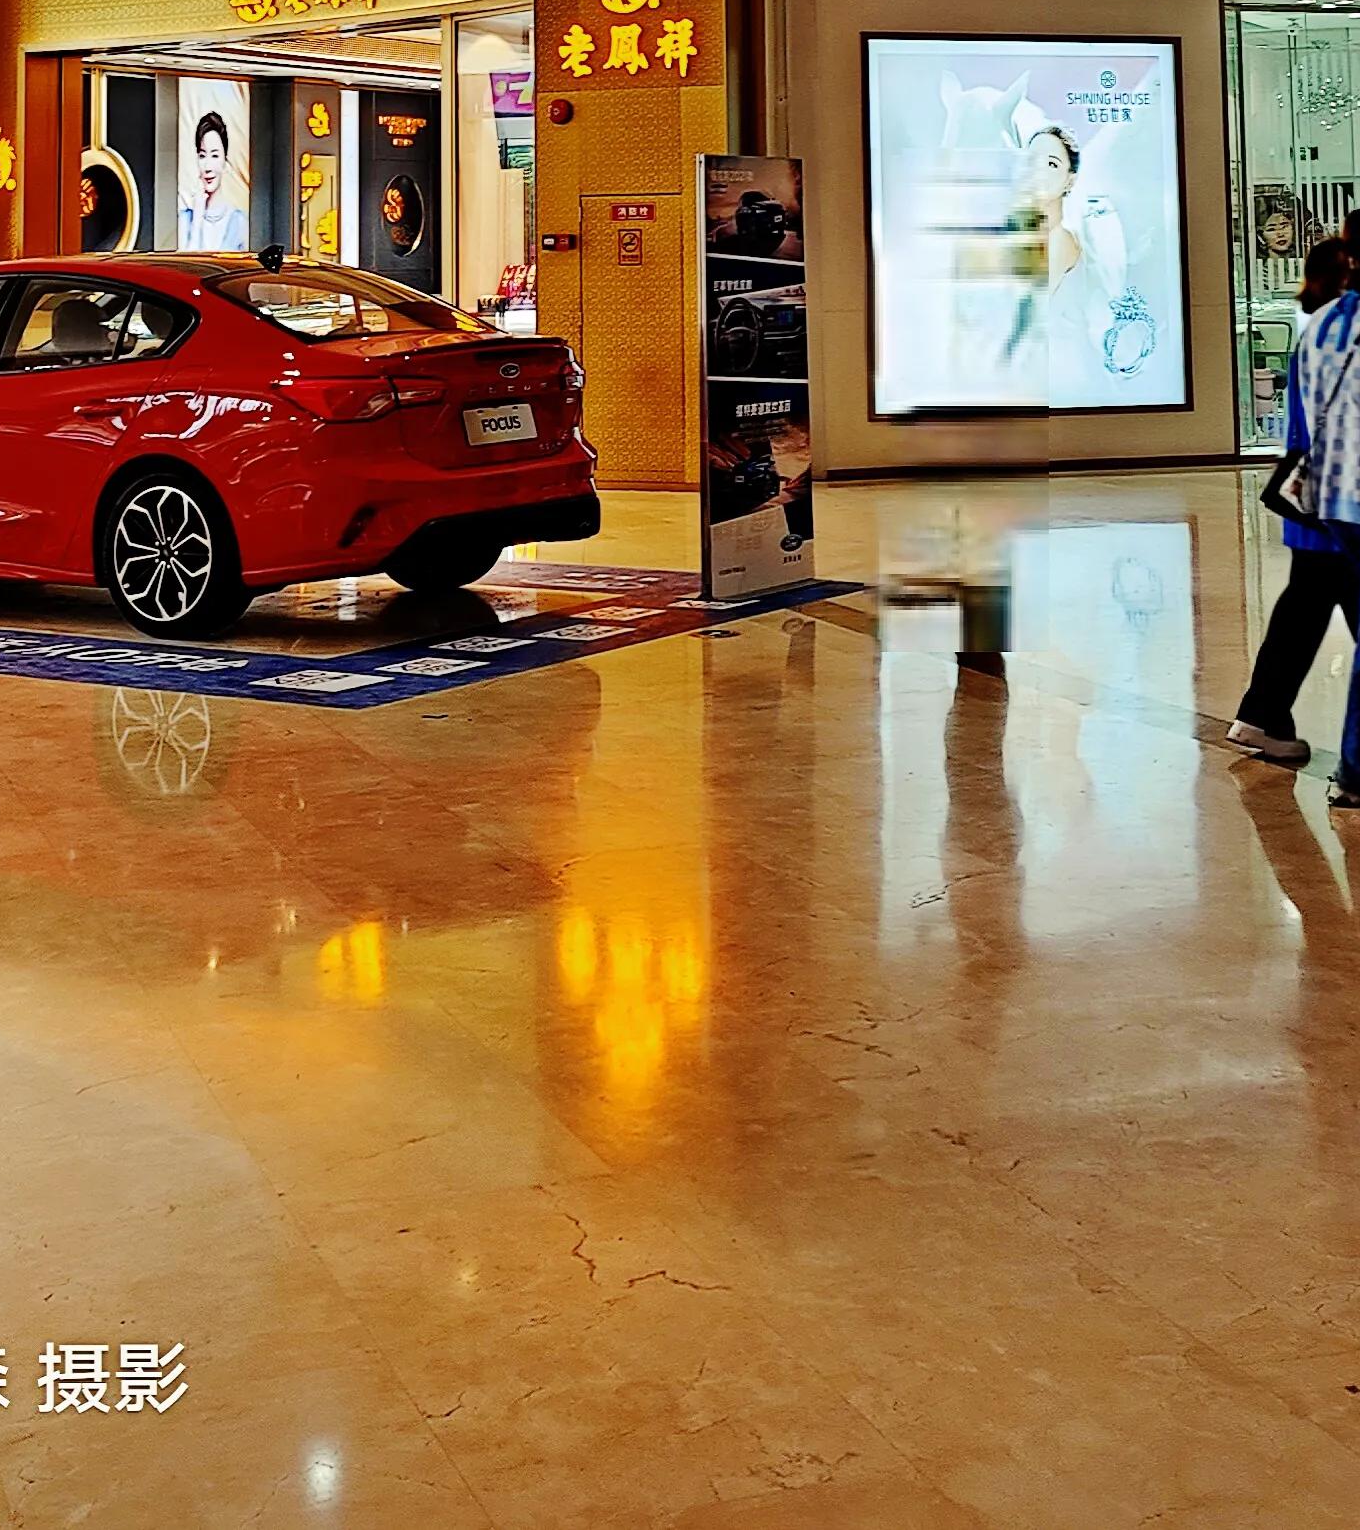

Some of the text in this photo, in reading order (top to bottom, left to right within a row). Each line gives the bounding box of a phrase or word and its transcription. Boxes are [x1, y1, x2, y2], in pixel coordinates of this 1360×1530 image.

[557, 18, 698, 78] 老鳳祥
[1066, 92, 1151, 105] SHINING HOUSE
[1087, 108, 1133, 123] 钻石世家
[481, 415, 521, 432] FOCUS
